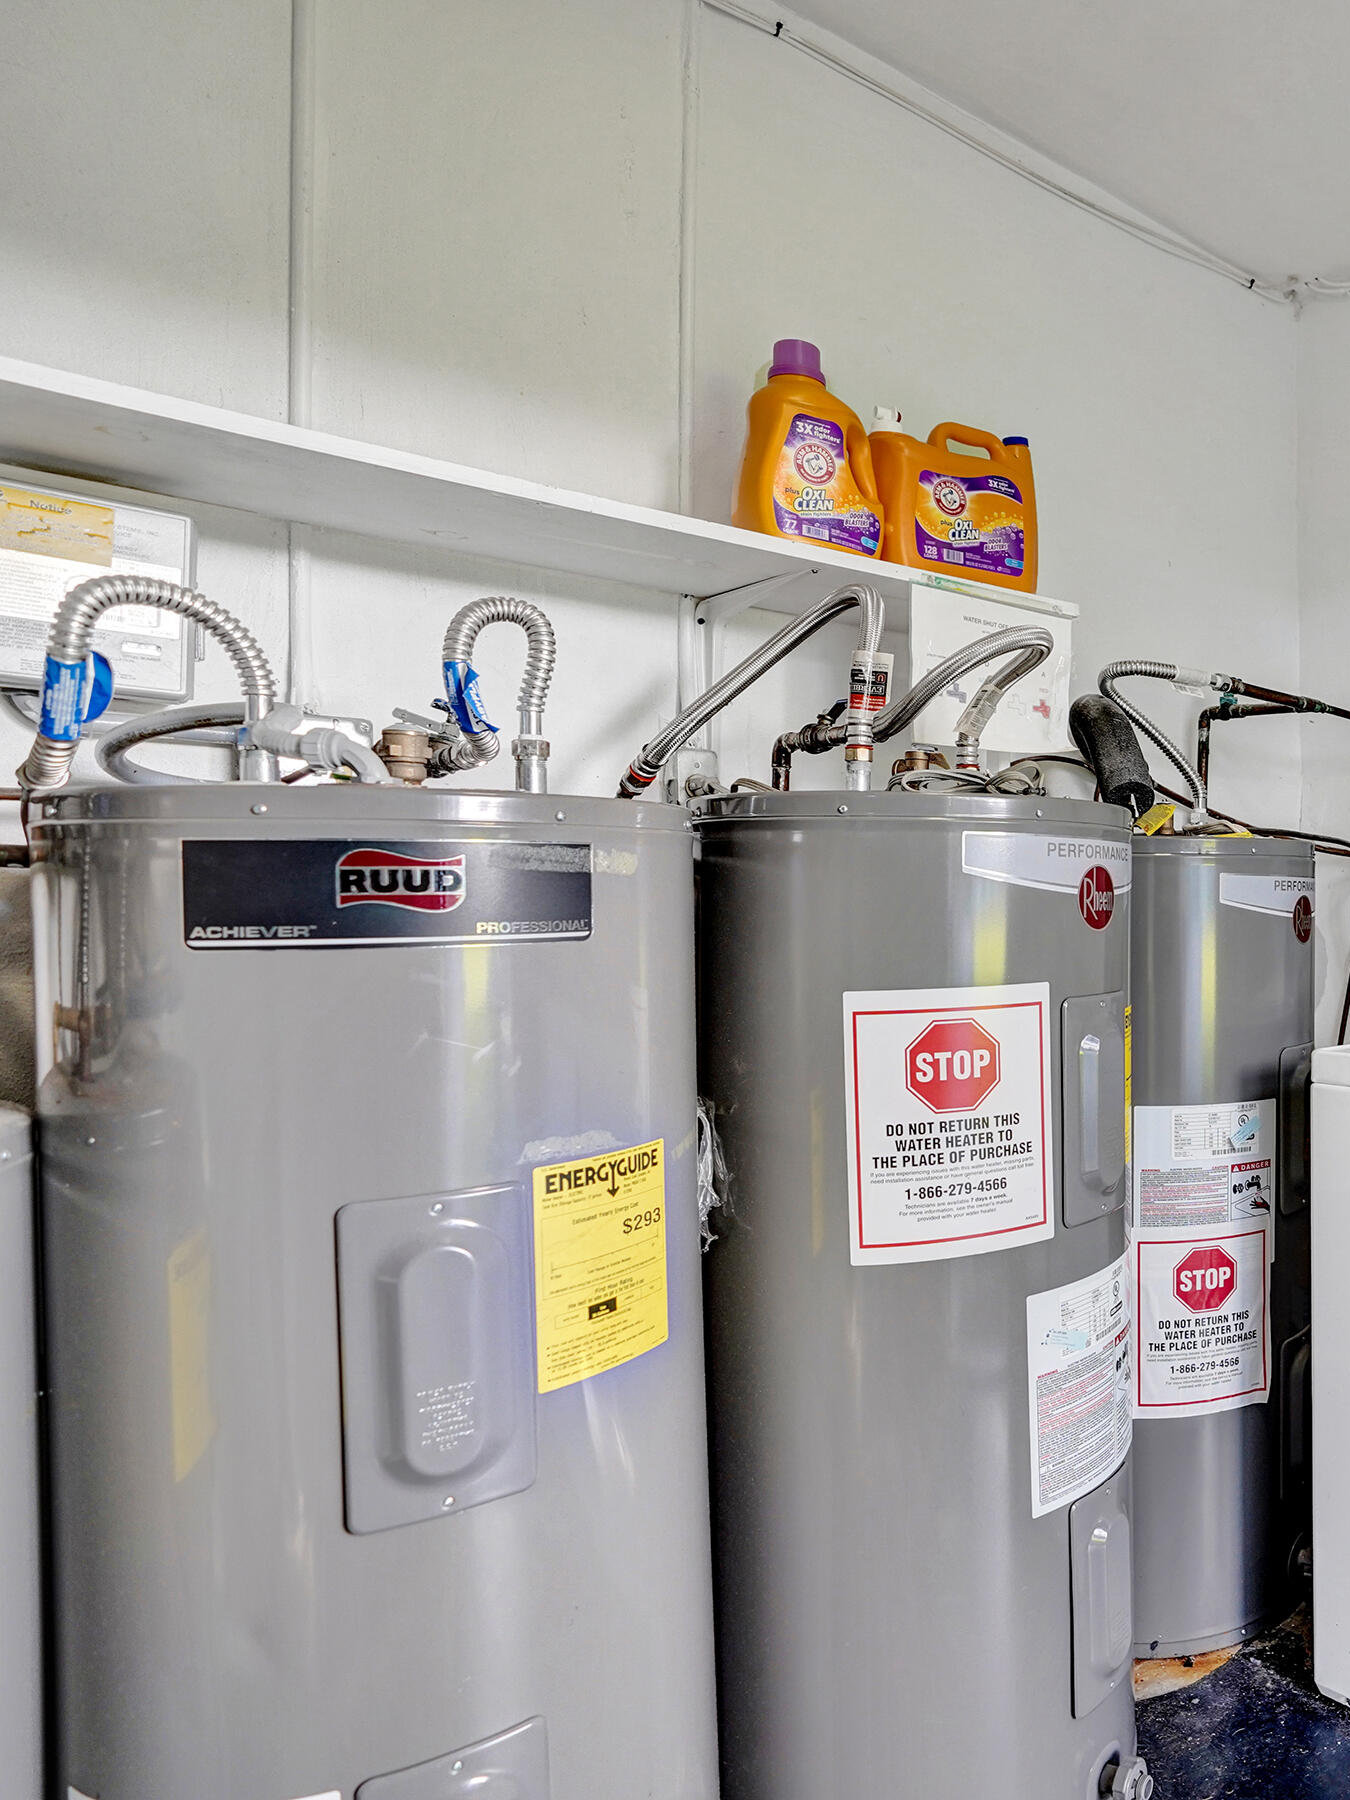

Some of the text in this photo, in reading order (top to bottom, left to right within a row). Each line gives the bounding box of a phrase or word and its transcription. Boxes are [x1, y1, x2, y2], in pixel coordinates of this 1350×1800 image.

[795, 421, 813, 435] 3X
[814, 425, 830, 434] odor
[784, 487, 800, 495] plus
[988, 479, 999, 488] 3X
[802, 487, 826, 500] OXI
[29, 499, 72, 515] Notice
[794, 498, 834, 511] CLEAN
[784, 519, 797, 529] 77
[954, 518, 973, 530] OXI
[948, 528, 979, 541] CLEAN
[923, 545, 938, 555] 128
[962, 615, 982, 625] WATER
[983, 620, 998, 628] SHUT
[1047, 842, 1128, 861] PERFORMANCE
[340, 868, 462, 893] RUUD
[1083, 866, 1113, 920] Rheem
[915, 1049, 991, 1084] STOP
[886, 1112, 1020, 1137] DO NOT RETURN THIS
[895, 1129, 1013, 1152] WATER HEATER TO
[872, 1141, 1033, 1169] THE PLACE OF PURCHASE
[545, 1148, 659, 1195] ENERGYGUIDE
[1241, 1161, 1270, 1171] DANGER
[904, 1176, 1007, 1200] 1-866-279-4566
[1180, 1266, 1231, 1292] STOP
[1159, 1310, 1250, 1330] DO NOT RETURN THIS
[1149, 1342, 1166, 1352] THE
[1169, 1341, 1198, 1351] PLACE
[1201, 1338, 1212, 1349] OF
[1215, 1329, 1257, 1346] PURCHASE
[1164, 1322, 1245, 1341] WATER HEATER TO
[1170, 1356, 1240, 1374] 1-866-279-4566
